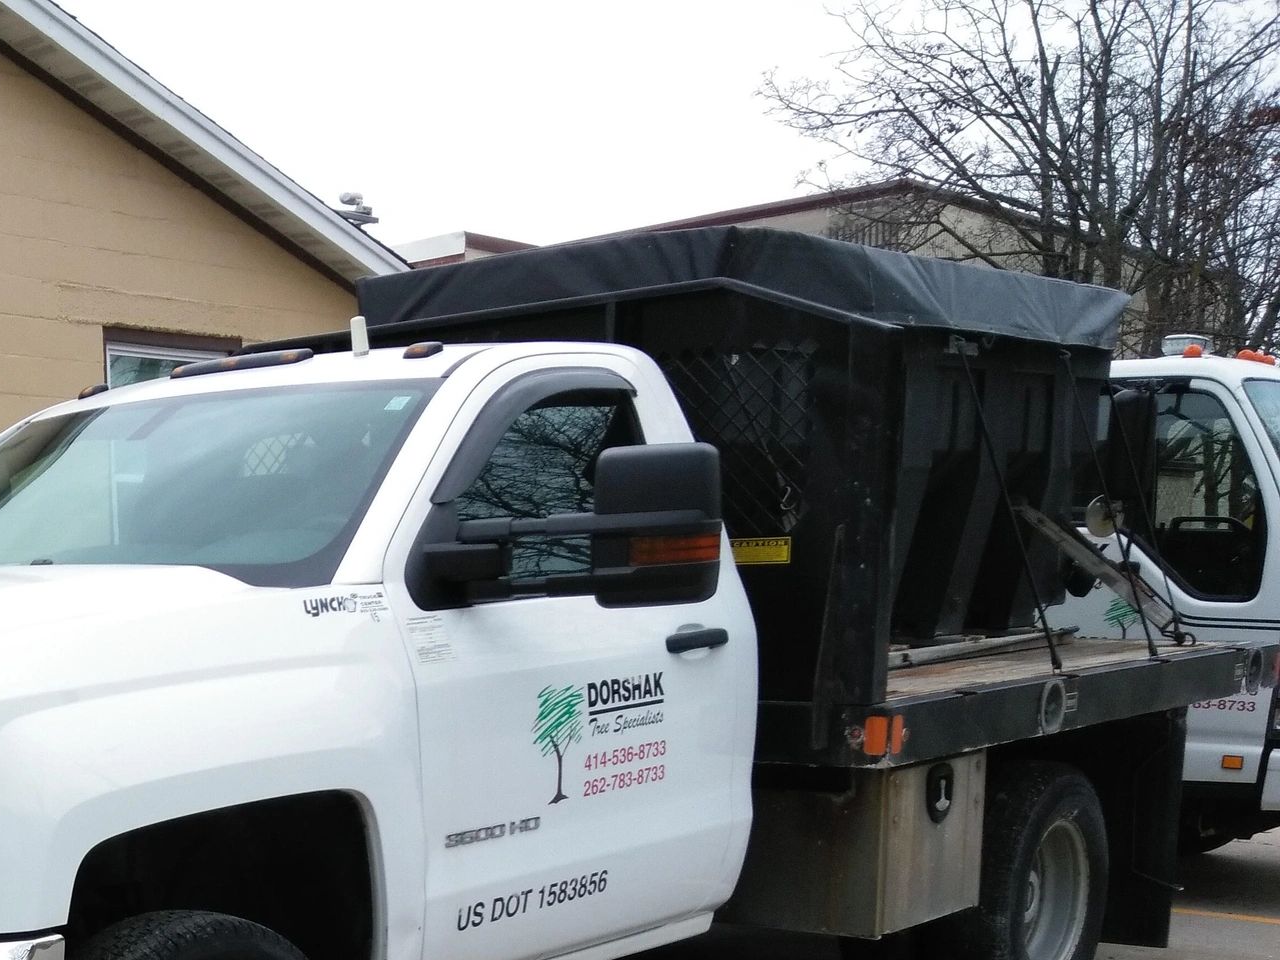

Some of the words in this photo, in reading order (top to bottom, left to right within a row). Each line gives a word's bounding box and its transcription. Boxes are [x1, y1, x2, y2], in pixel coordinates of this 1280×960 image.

[732, 539, 786, 548] CAUTION
[302, 596, 347, 617] LYNCH
[587, 671, 665, 708] DORSHAK
[588, 717, 610, 737] Tree
[613, 709, 665, 735] Specialists
[584, 739, 667, 771] 414-536-8733
[583, 764, 666, 797] 262-783-8733
[509, 816, 541, 836] HD
[457, 901, 486, 931] US
[490, 888, 533, 923] DOT
[538, 869, 609, 910] 1583856
